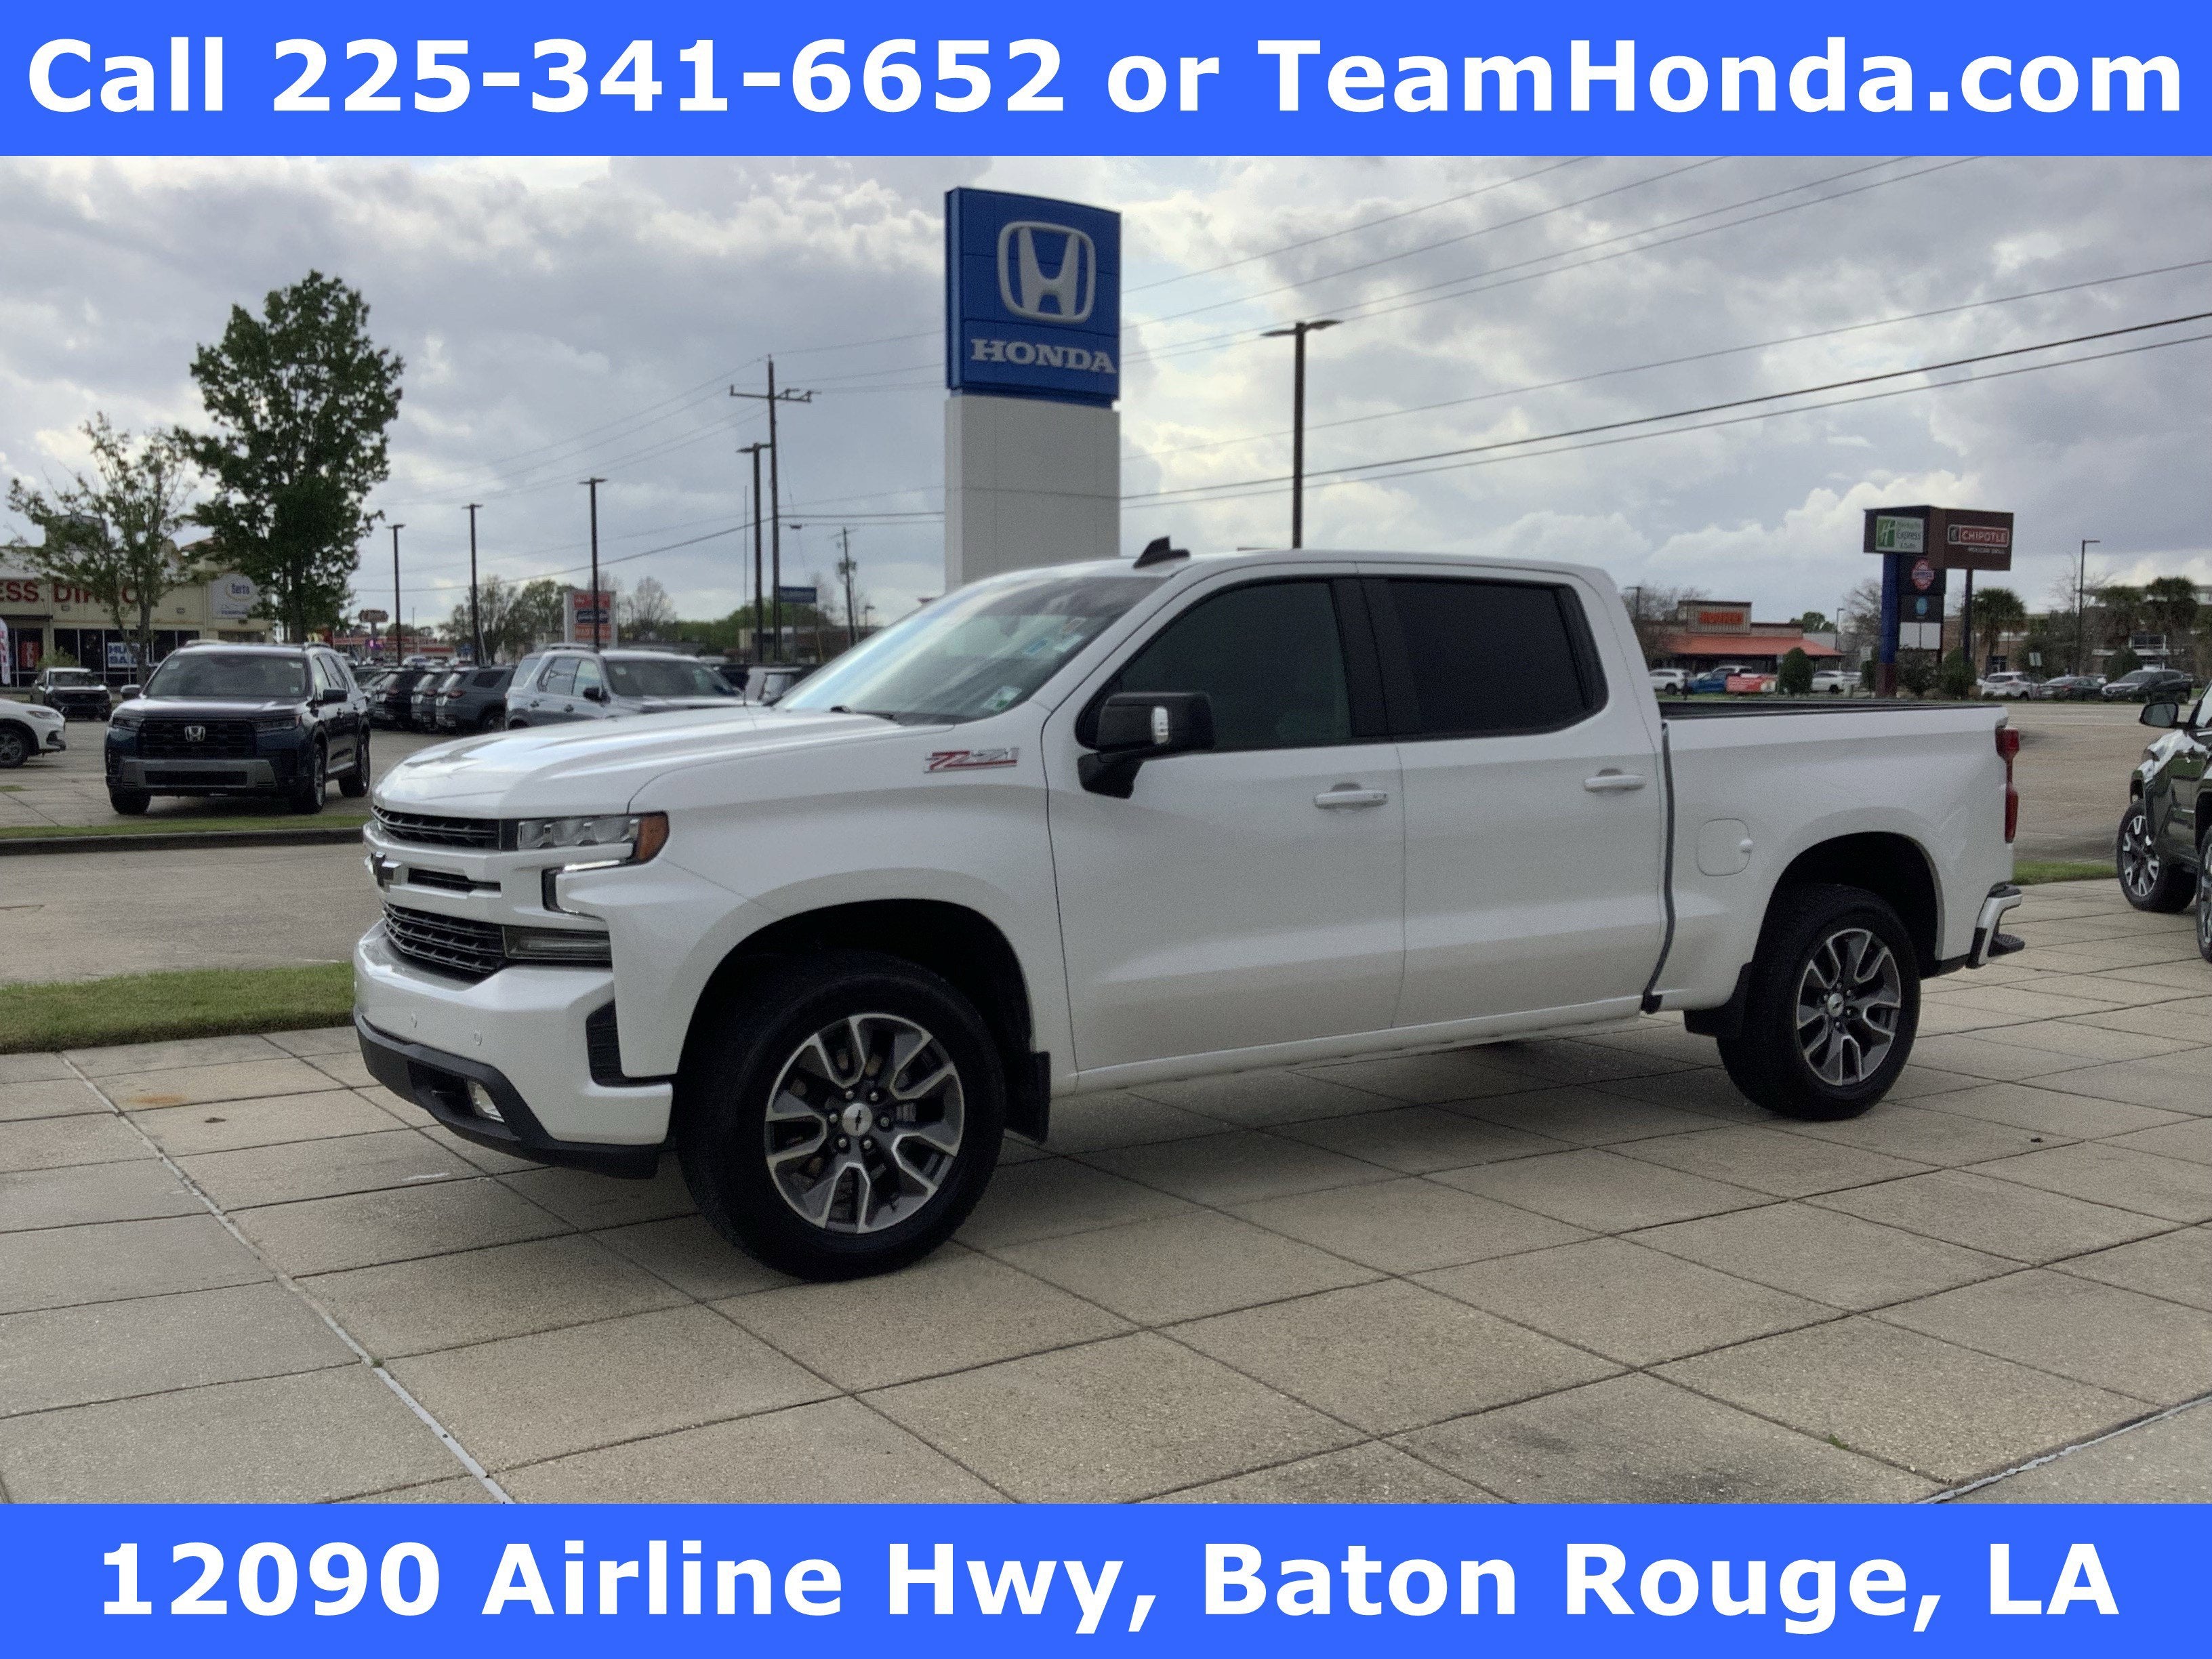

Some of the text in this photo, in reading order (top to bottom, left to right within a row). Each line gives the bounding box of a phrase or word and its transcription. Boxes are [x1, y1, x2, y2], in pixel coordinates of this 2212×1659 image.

[970, 338, 1118, 374] HONDA
[1961, 530, 2007, 543] CHIPOTLE
[924, 747, 1019, 774] Z71
